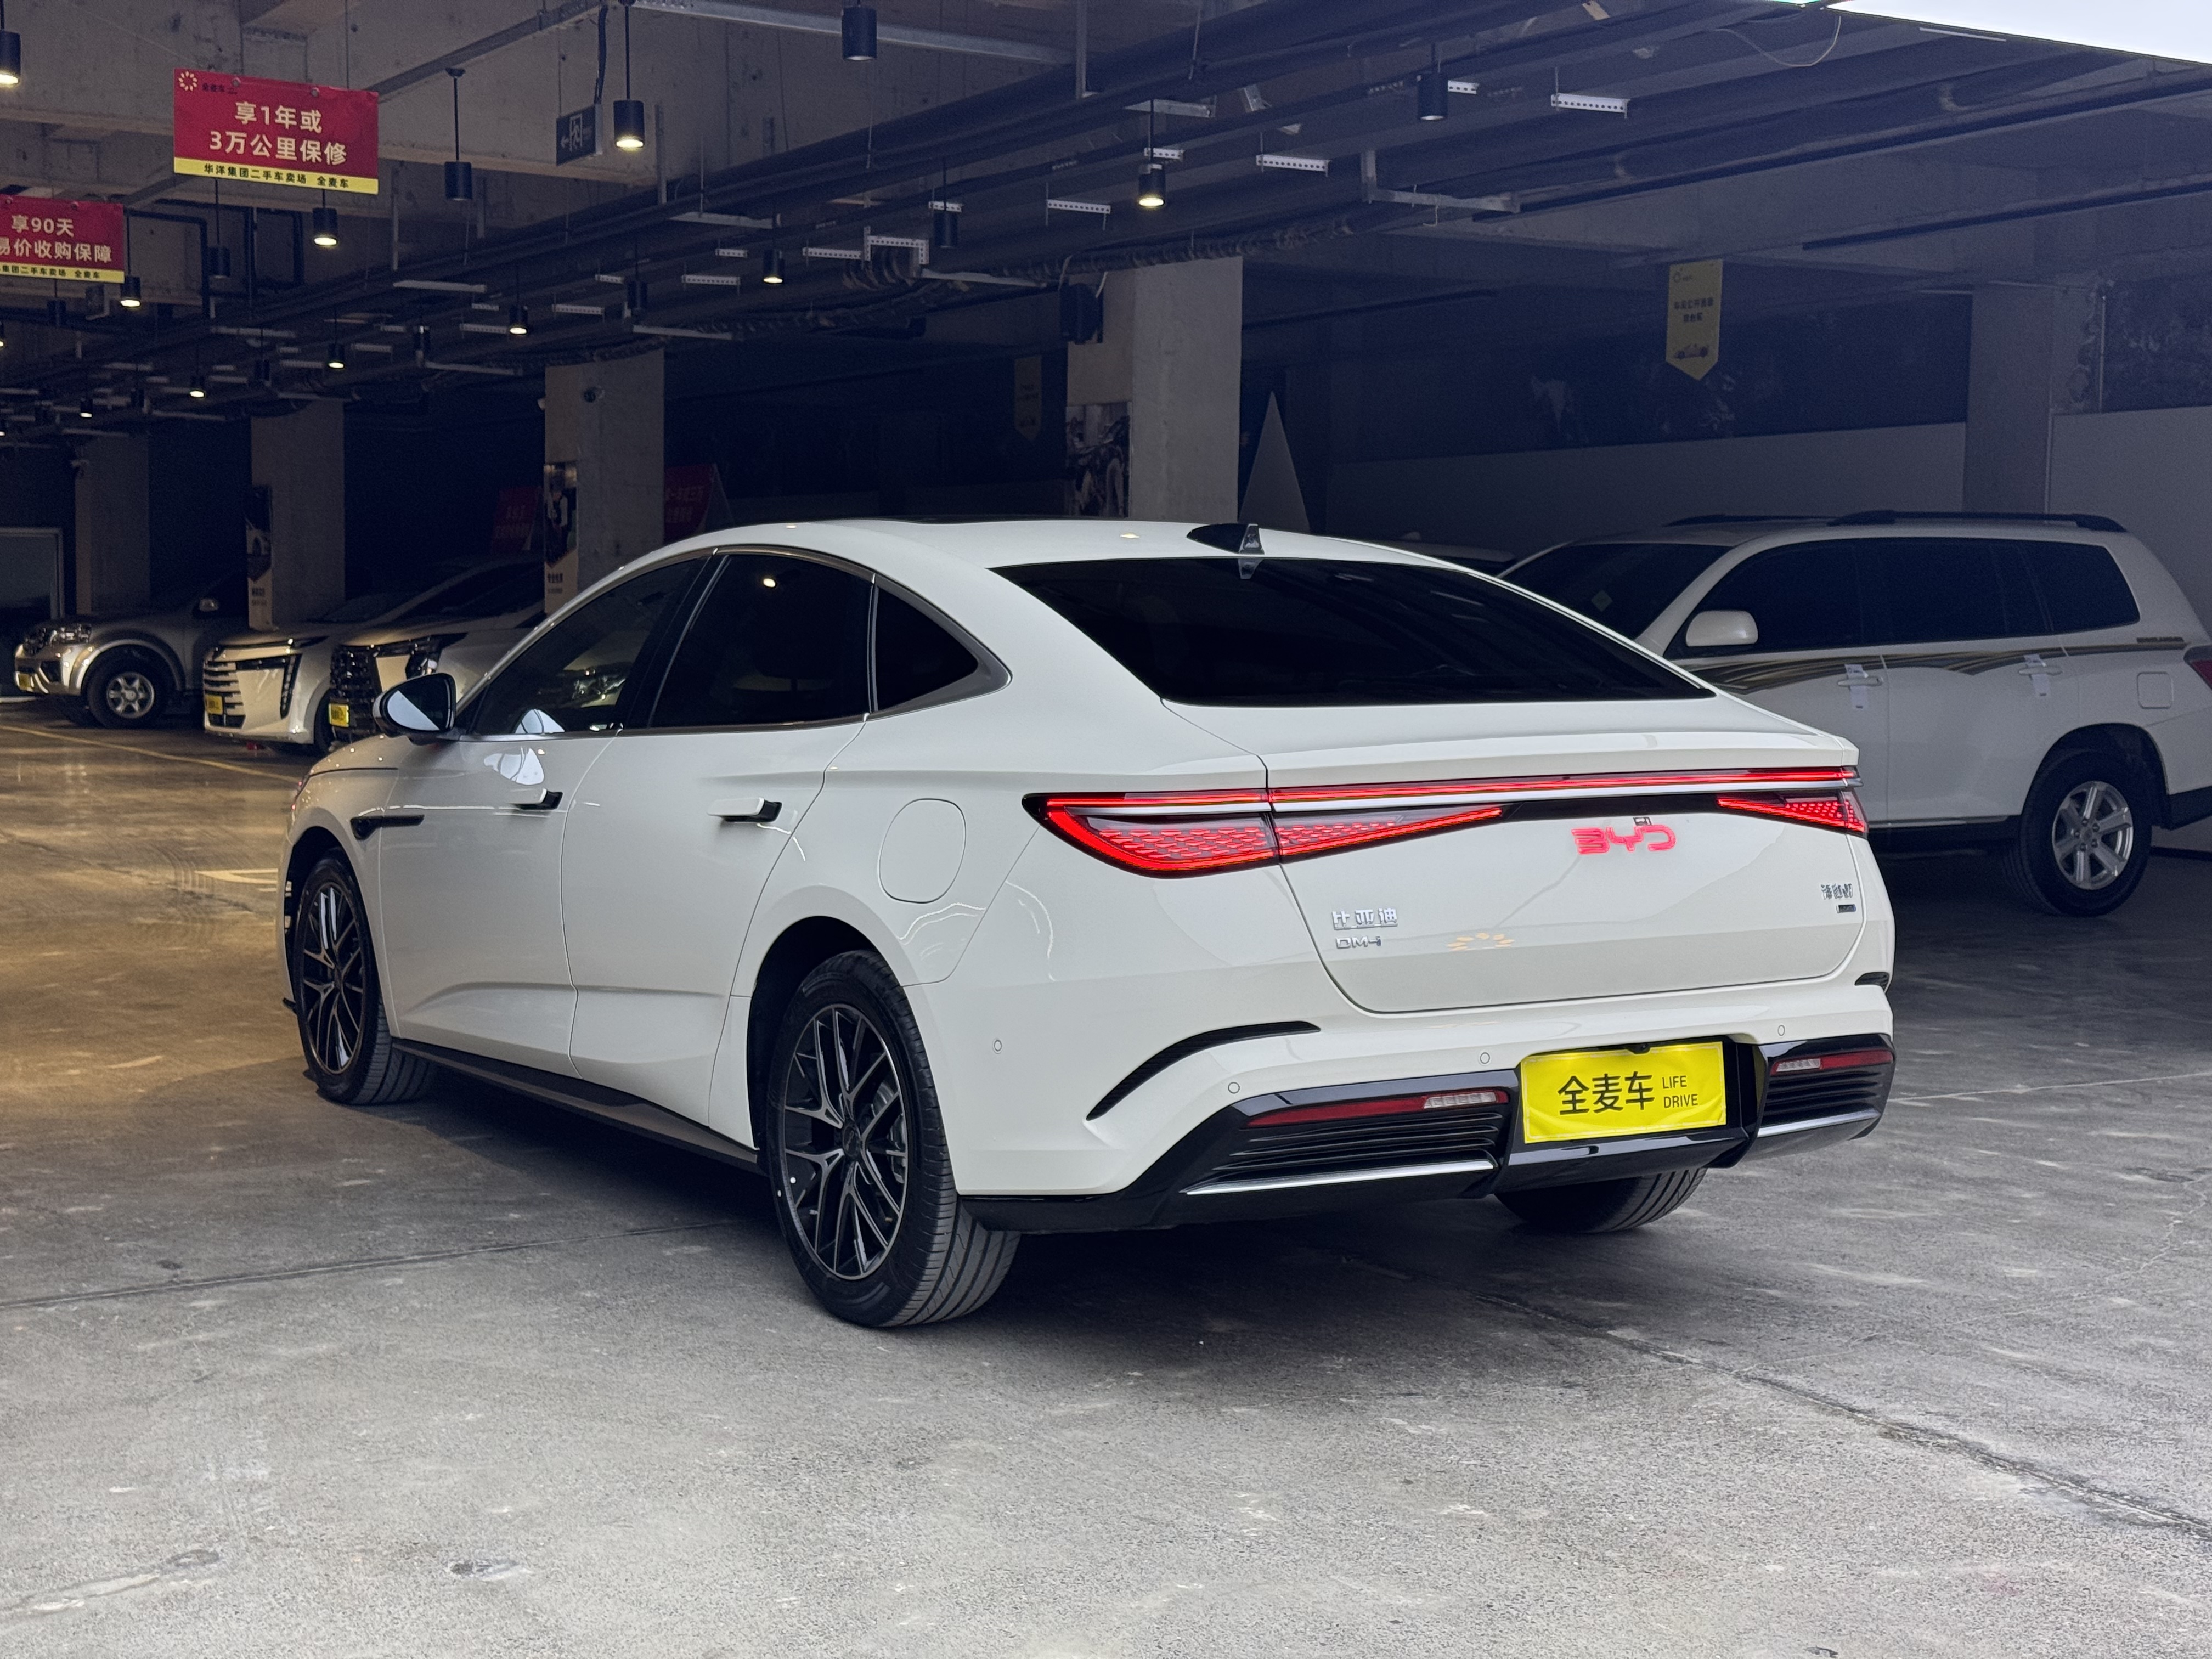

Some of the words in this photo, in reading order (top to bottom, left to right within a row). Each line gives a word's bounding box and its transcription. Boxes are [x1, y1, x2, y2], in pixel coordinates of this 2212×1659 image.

[235, 101, 323, 134] 享1年或
[210, 131, 347, 165] 3万公里保修
[204, 163, 307, 185] 华洋集团二手车卖场
[12, 215, 74, 238] 享90天
[1571, 825, 1677, 855] BYD
[1332, 908, 1398, 930] 比亚迪
[1336, 936, 1381, 949] DM-i
[1558, 1071, 1655, 1115] 全麦车
[1662, 1075, 1688, 1090] LIFE
[1663, 1093, 1699, 1109] DRIVE
